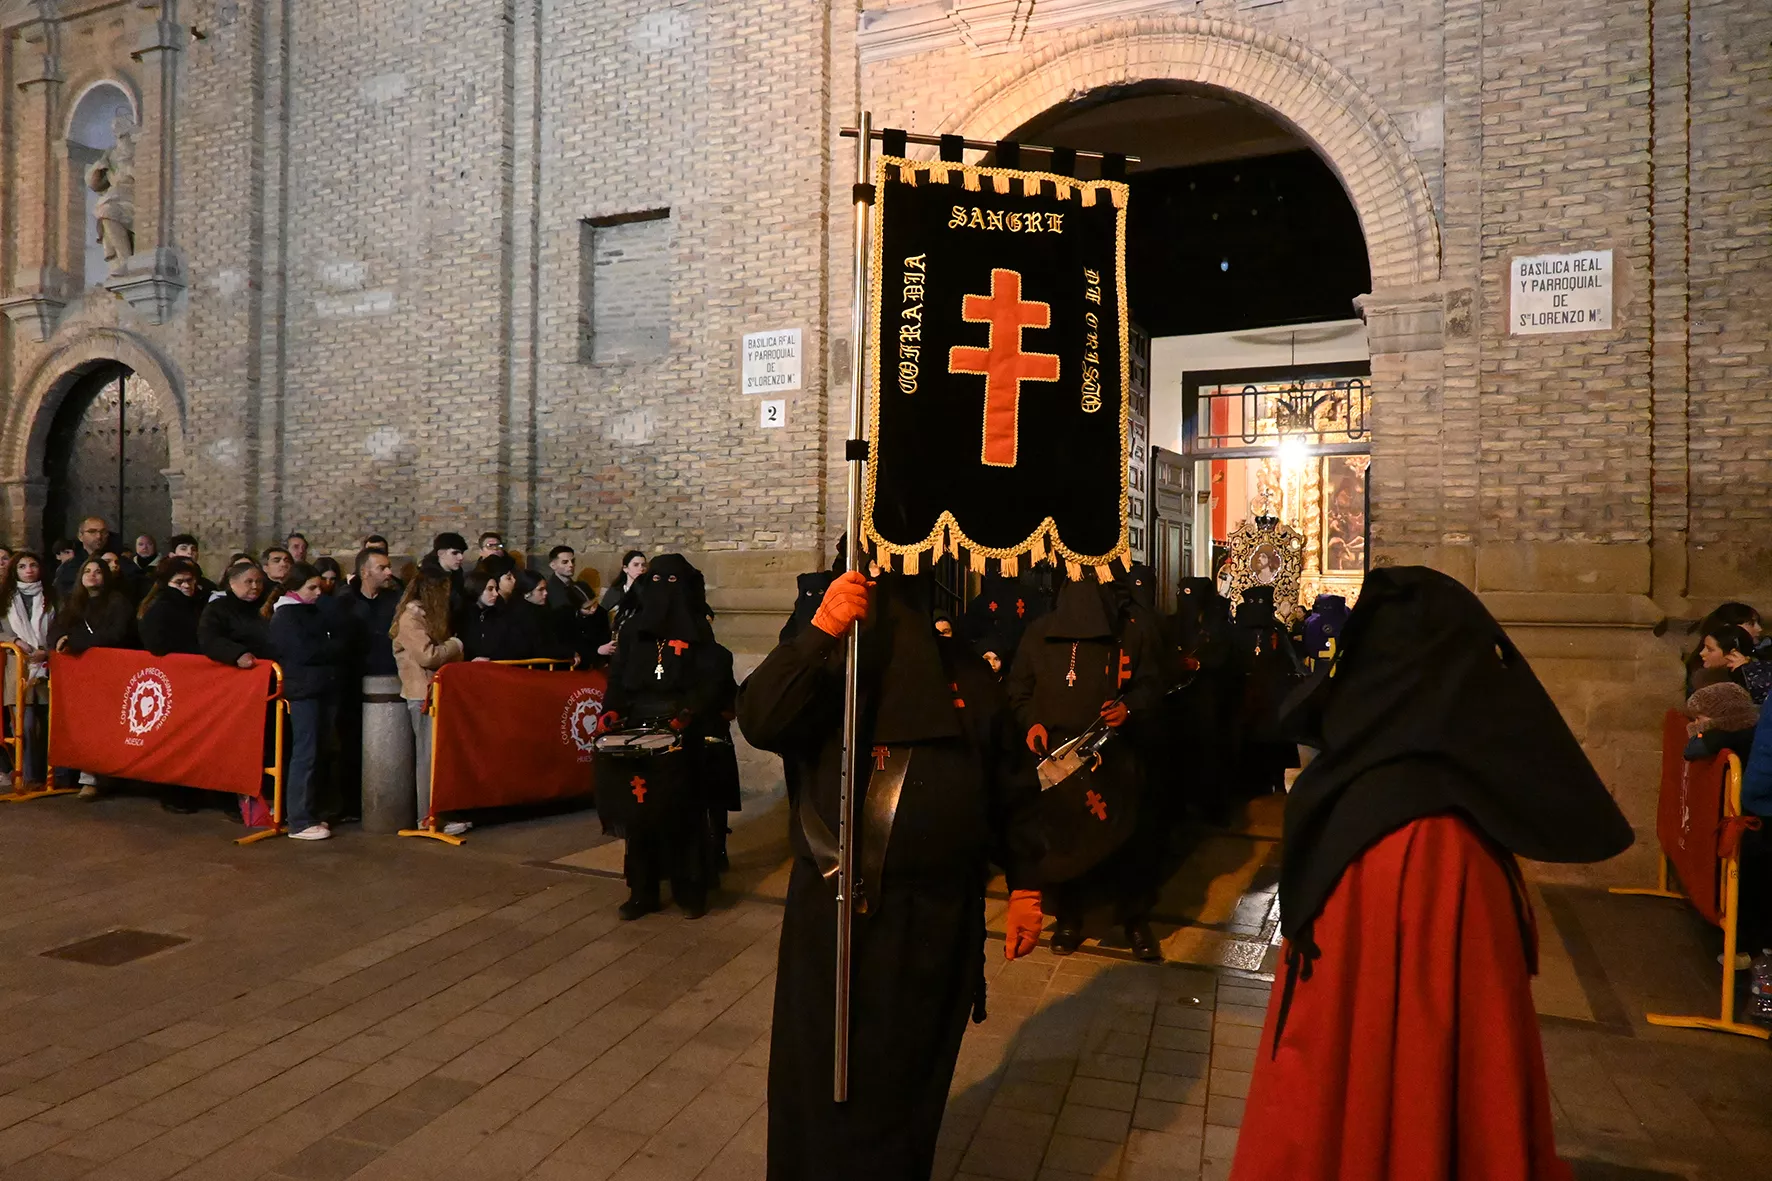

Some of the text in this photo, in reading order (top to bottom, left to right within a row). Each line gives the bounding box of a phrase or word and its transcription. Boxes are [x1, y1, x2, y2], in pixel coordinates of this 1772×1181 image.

[948, 205, 1064, 234] SANGRE
[1520, 258, 1602, 277] BASÍLICA REAL
[1521, 275, 1602, 293] Y PARROQUIAL
[1553, 294, 1568, 307] DE
[898, 253, 927, 395] COFRADIA
[1531, 310, 1585, 326] LORENZO
[1081, 266, 1102, 414] DE CRISTO
[748, 348, 796, 362] Y PARROQUIAL
[766, 362, 776, 373] DE
[754, 374, 785, 387] LORENZO
[768, 406, 777, 421] 2
[129, 675, 138, 687] DE
[136, 669, 145, 679] LA
[567, 695, 577, 706] DE
[573, 690, 583, 699] LA
[580, 687, 604, 700] PRECIOS
[124, 737, 144, 747] HUESCA
[576, 755, 593, 763] HUES
